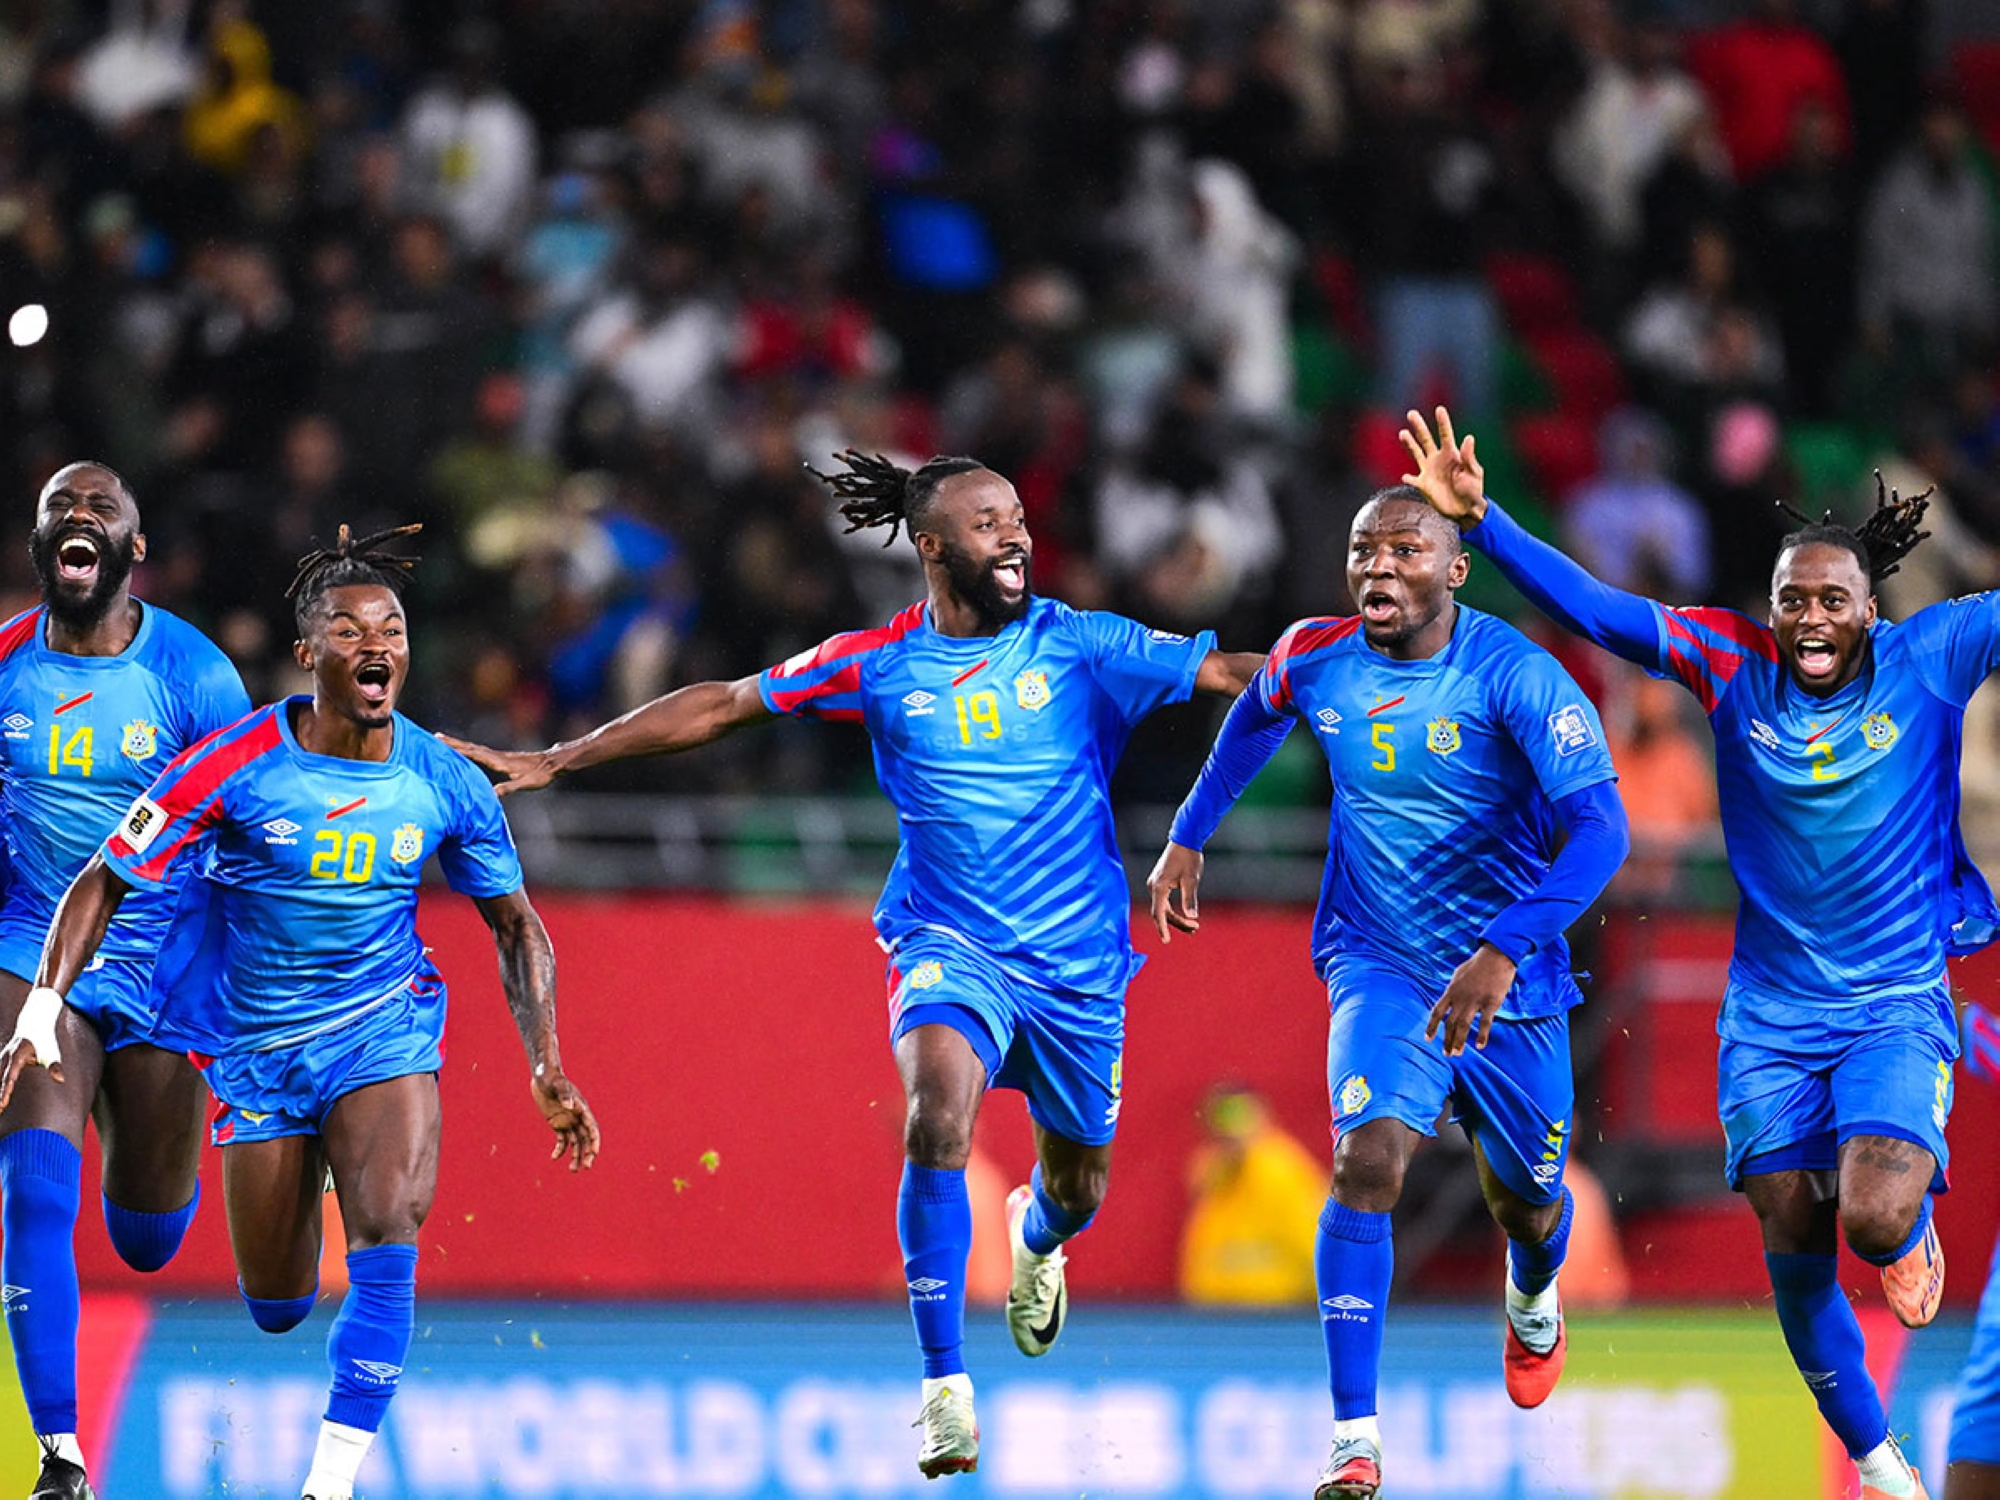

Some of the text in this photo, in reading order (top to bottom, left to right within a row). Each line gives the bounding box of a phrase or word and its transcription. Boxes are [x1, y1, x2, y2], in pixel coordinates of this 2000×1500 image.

[953, 691, 1003, 745] 19
[48, 724, 94, 777] 14
[1371, 722, 1396, 772] 5
[1805, 741, 1840, 781] 2
[264, 834, 298, 846] umbro
[310, 829, 377, 883] 20
[398, 1378, 766, 1494] WORLD
